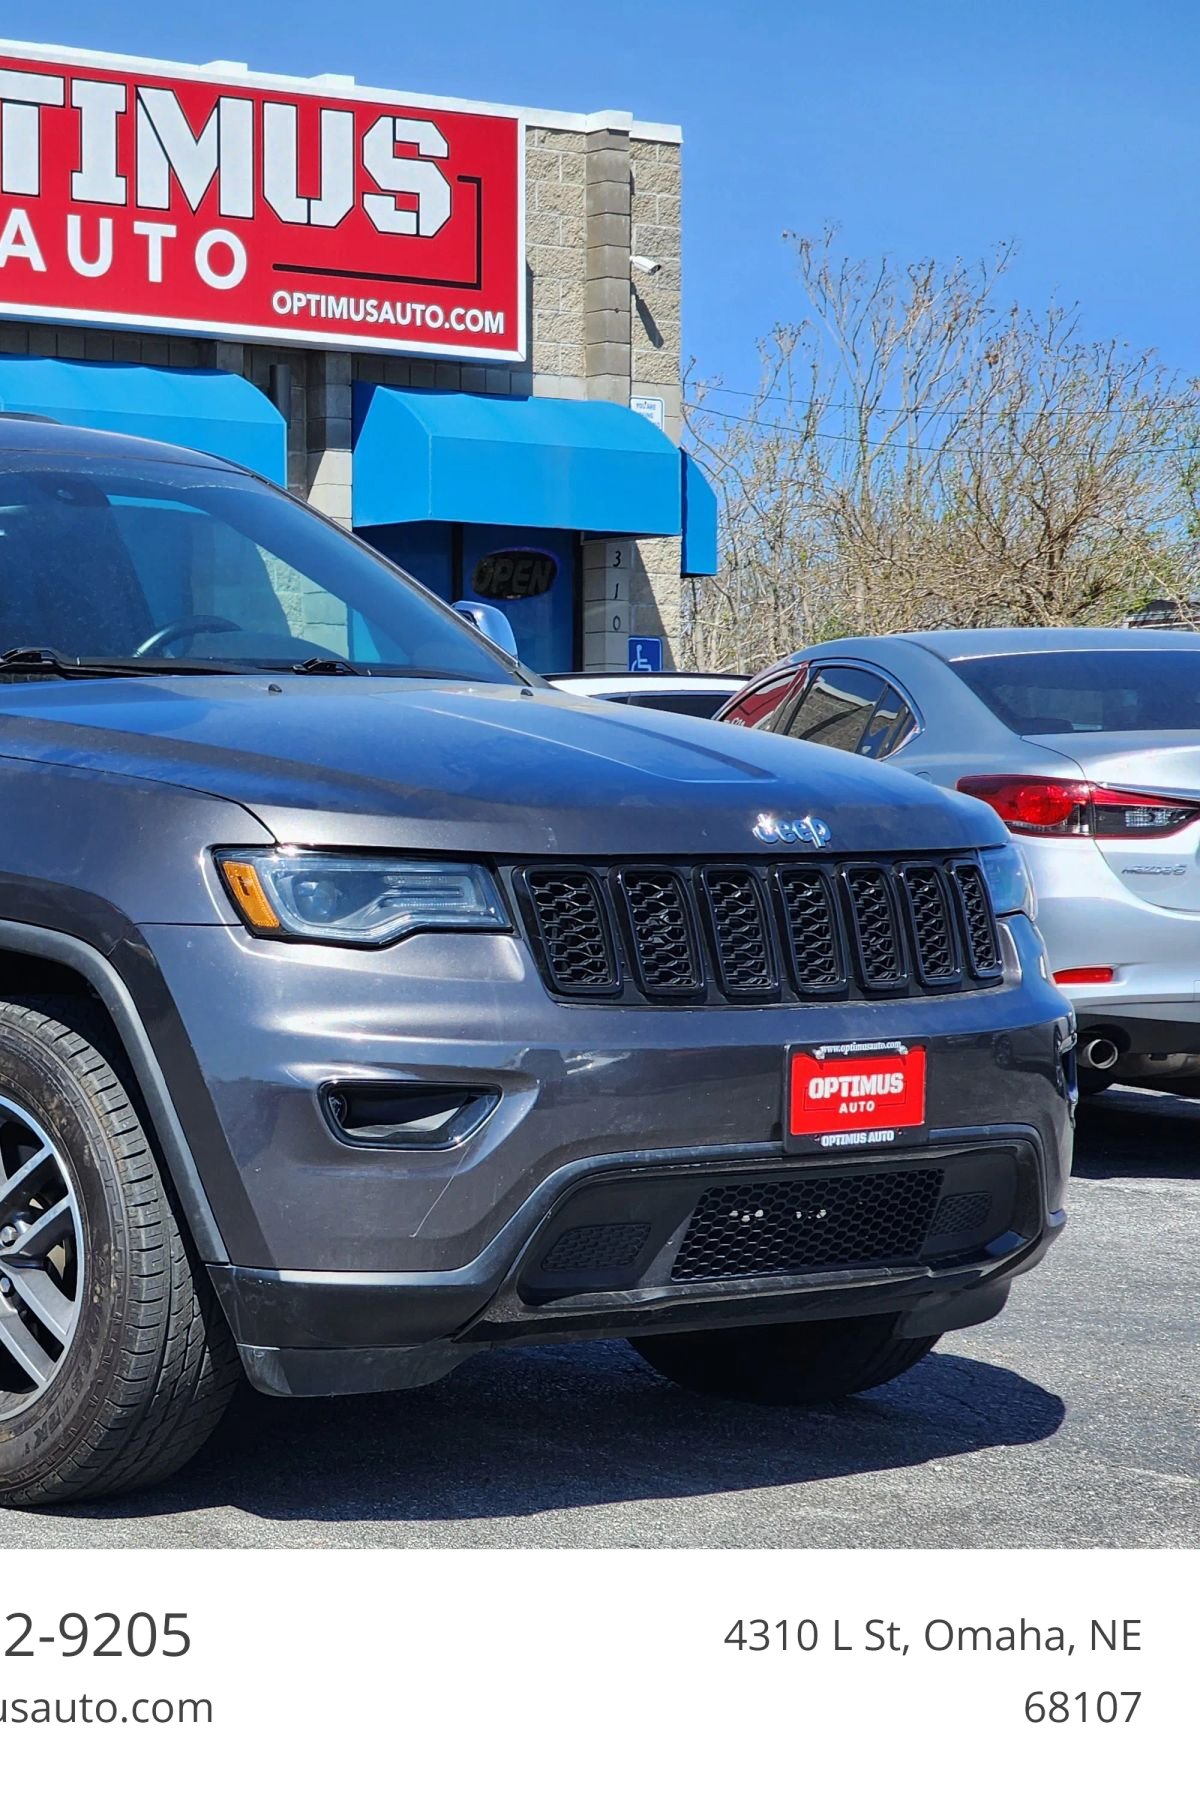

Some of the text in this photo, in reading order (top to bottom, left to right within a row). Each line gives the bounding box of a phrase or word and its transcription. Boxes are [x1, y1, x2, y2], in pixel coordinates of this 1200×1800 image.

[271, 289, 506, 335] OPTIMUSAUTO.COM
[475, 557, 553, 596] OPEN
[752, 813, 832, 848] Jeep
[808, 1072, 904, 1099] OPTIMUS
[838, 1100, 876, 1114] AUTO
[821, 1130, 895, 1147] OPTIMUS AUTO
